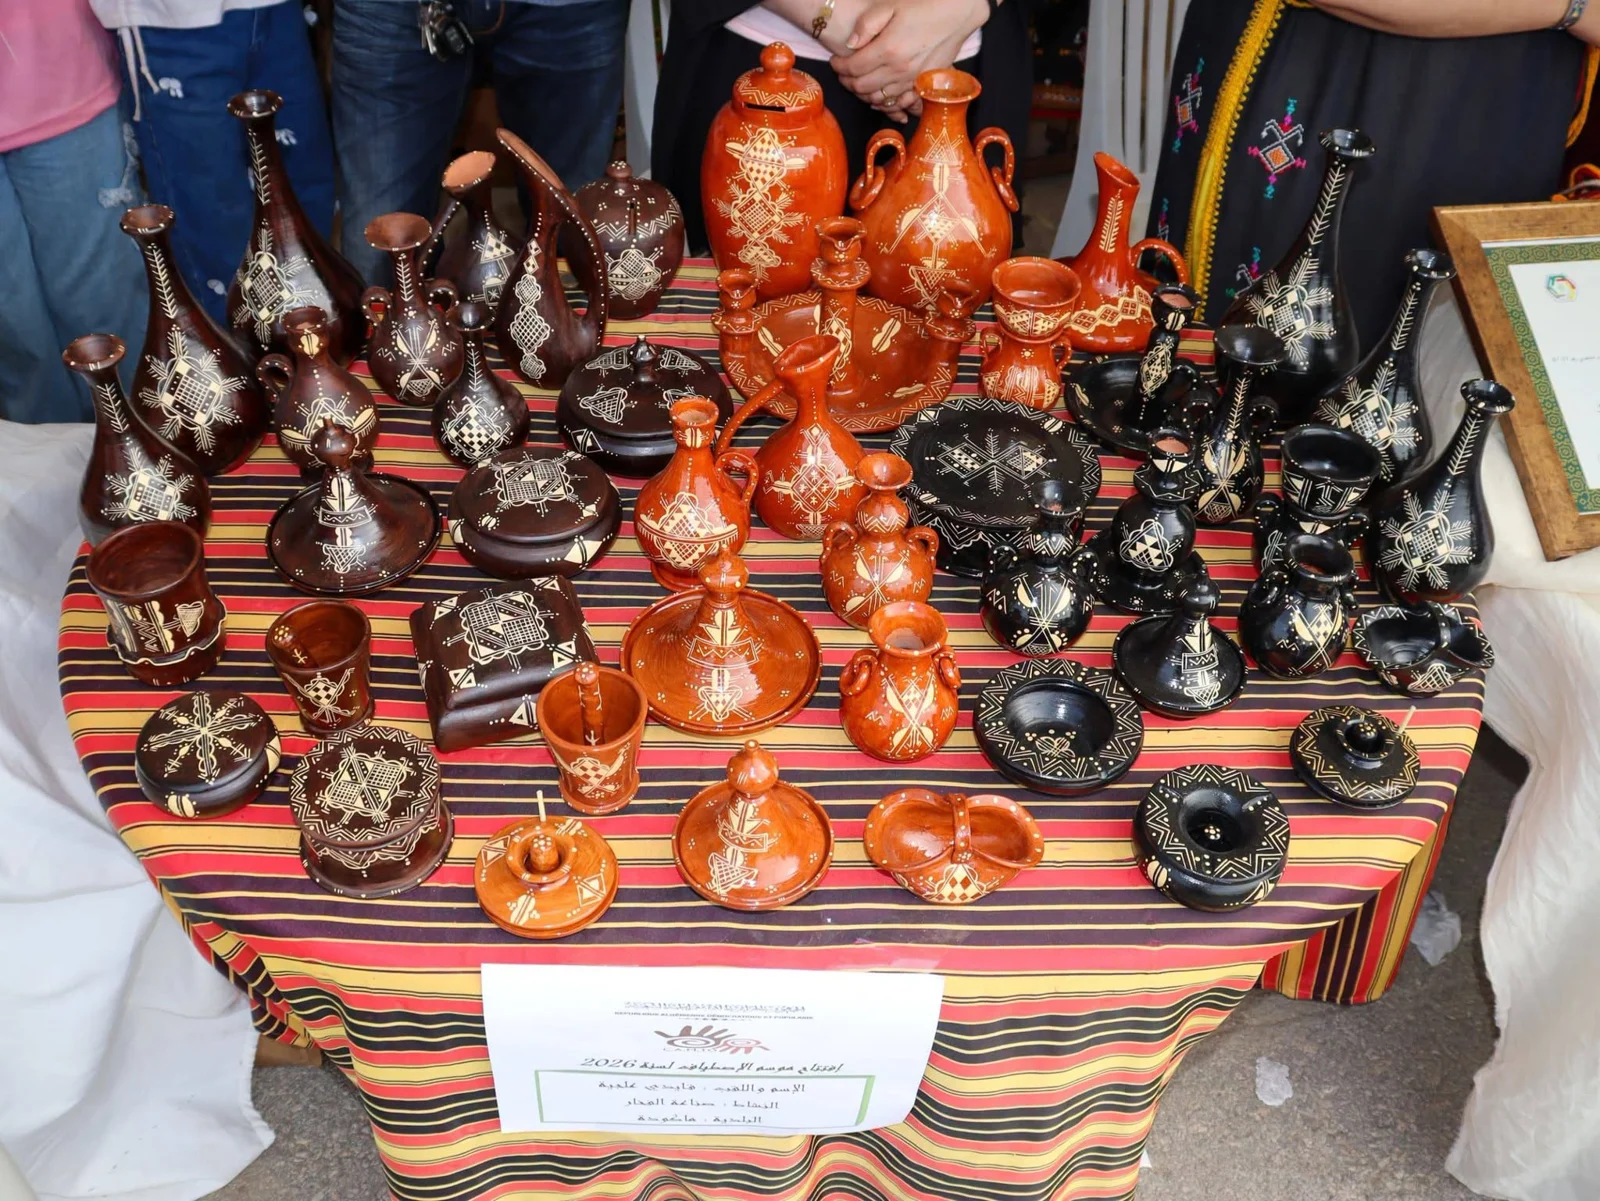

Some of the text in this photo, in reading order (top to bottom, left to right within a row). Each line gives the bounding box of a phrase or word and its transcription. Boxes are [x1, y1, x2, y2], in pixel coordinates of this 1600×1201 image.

[580, 1057, 638, 1069] 2026
[639, 1061, 676, 1070] لسنة
[755, 1064, 794, 1074] موسم
[670, 1098, 715, 1107] صناعة
[733, 1100, 780, 1110] النشاط
[712, 1115, 762, 1124] البلدية
